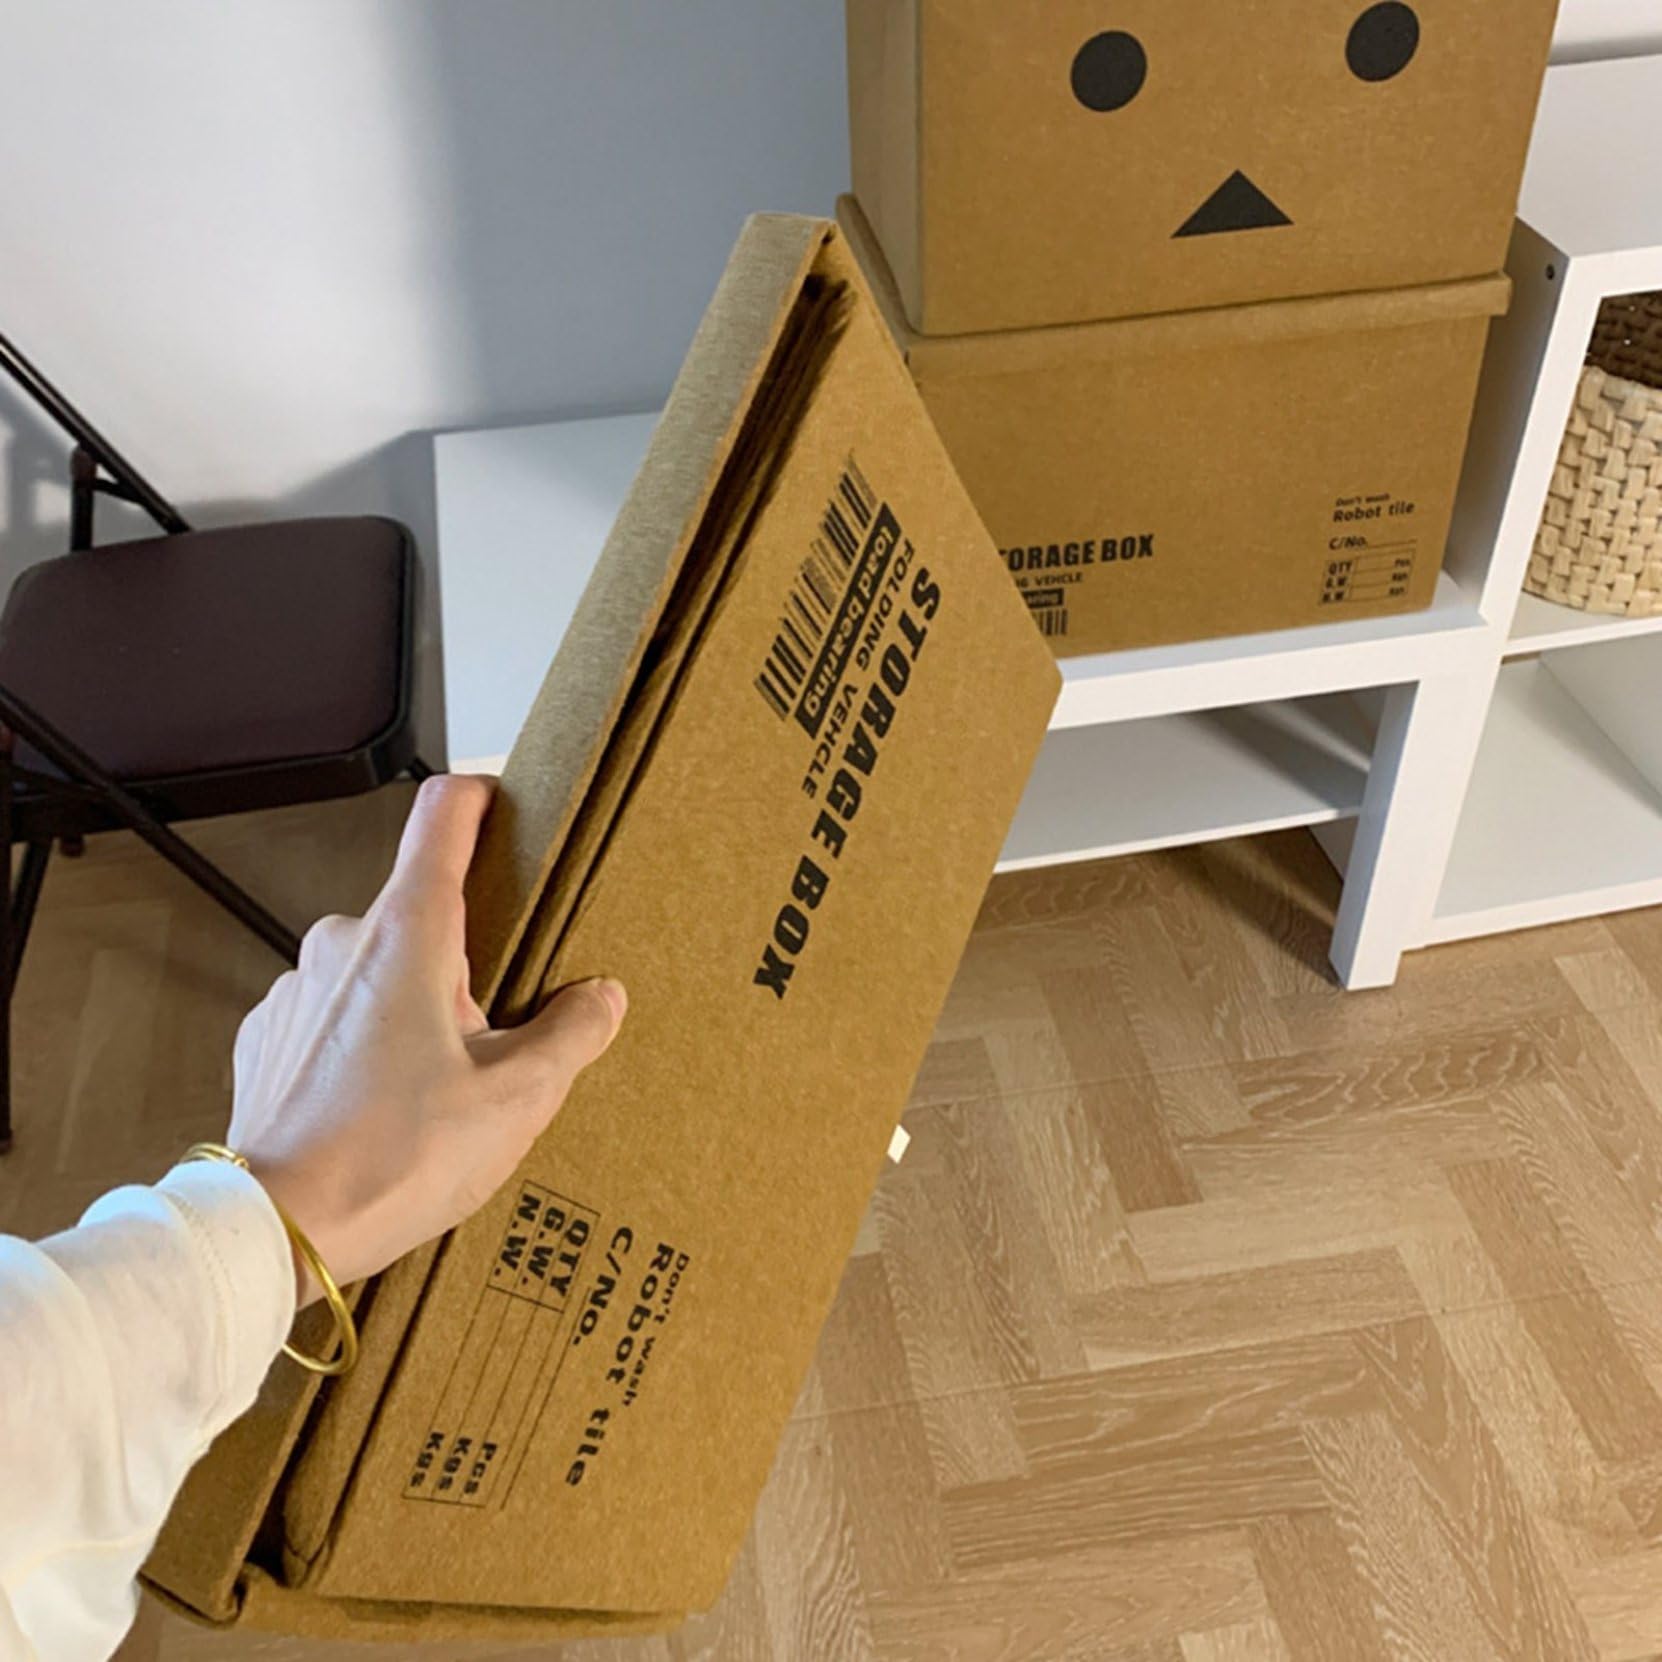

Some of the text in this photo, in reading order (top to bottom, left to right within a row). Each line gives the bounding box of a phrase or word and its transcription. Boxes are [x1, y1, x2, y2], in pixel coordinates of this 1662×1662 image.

[1101, 533, 1154, 562] BOX
[1333, 506, 1381, 522] Robot
[802, 538, 915, 798] FOLDING VEHCLE
[804, 526, 894, 717] load bearing
[753, 567, 940, 999] STORAGE BOX
[495, 1193, 542, 1276] N.W.
[522, 1207, 565, 1285] G.W.
[550, 1219, 589, 1297] QTY
[573, 1226, 633, 1346] C/No.
[566, 1242, 674, 1486] Robot tile
[622, 1252, 690, 1406] Don't wash
